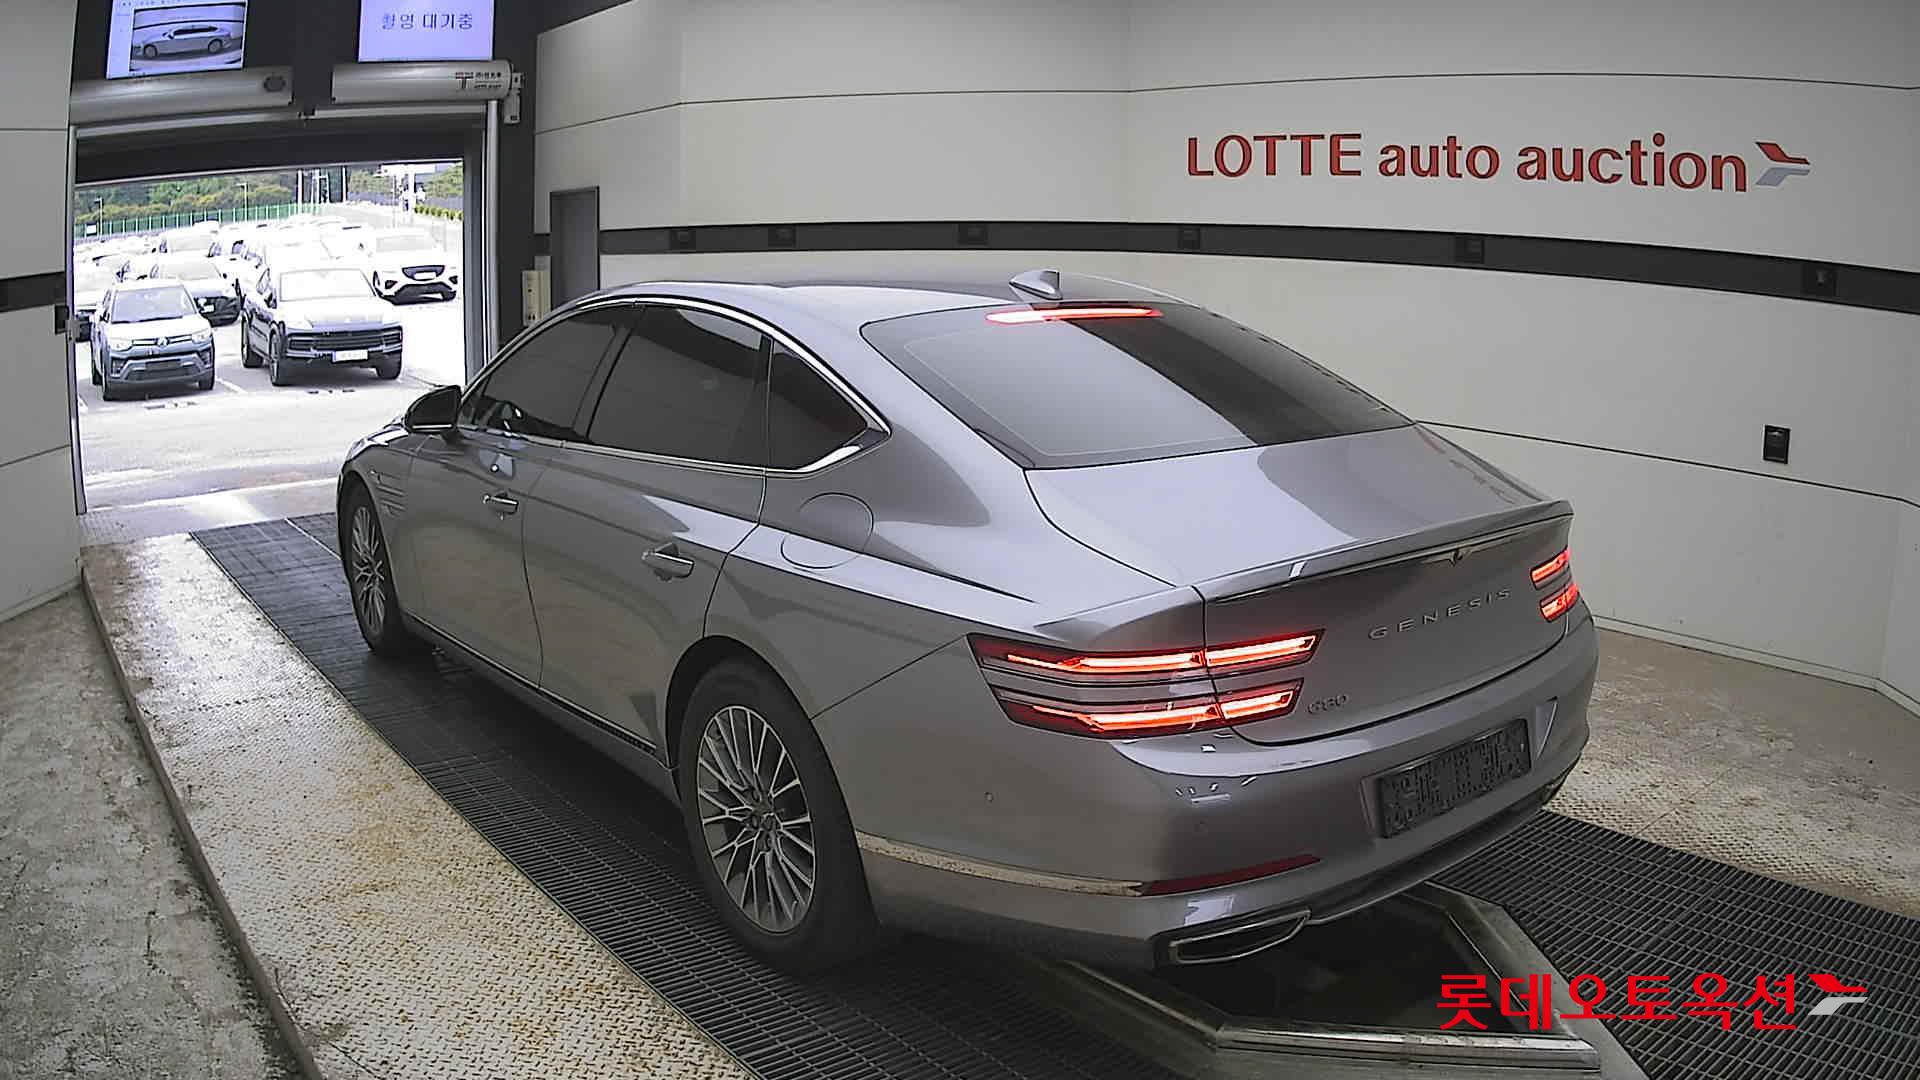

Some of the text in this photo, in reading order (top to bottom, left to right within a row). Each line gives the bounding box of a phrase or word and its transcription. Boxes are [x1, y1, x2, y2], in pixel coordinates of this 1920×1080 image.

[1187, 132, 1747, 192] LOTTE auto auction
[1368, 588, 1511, 640] GENESIS
